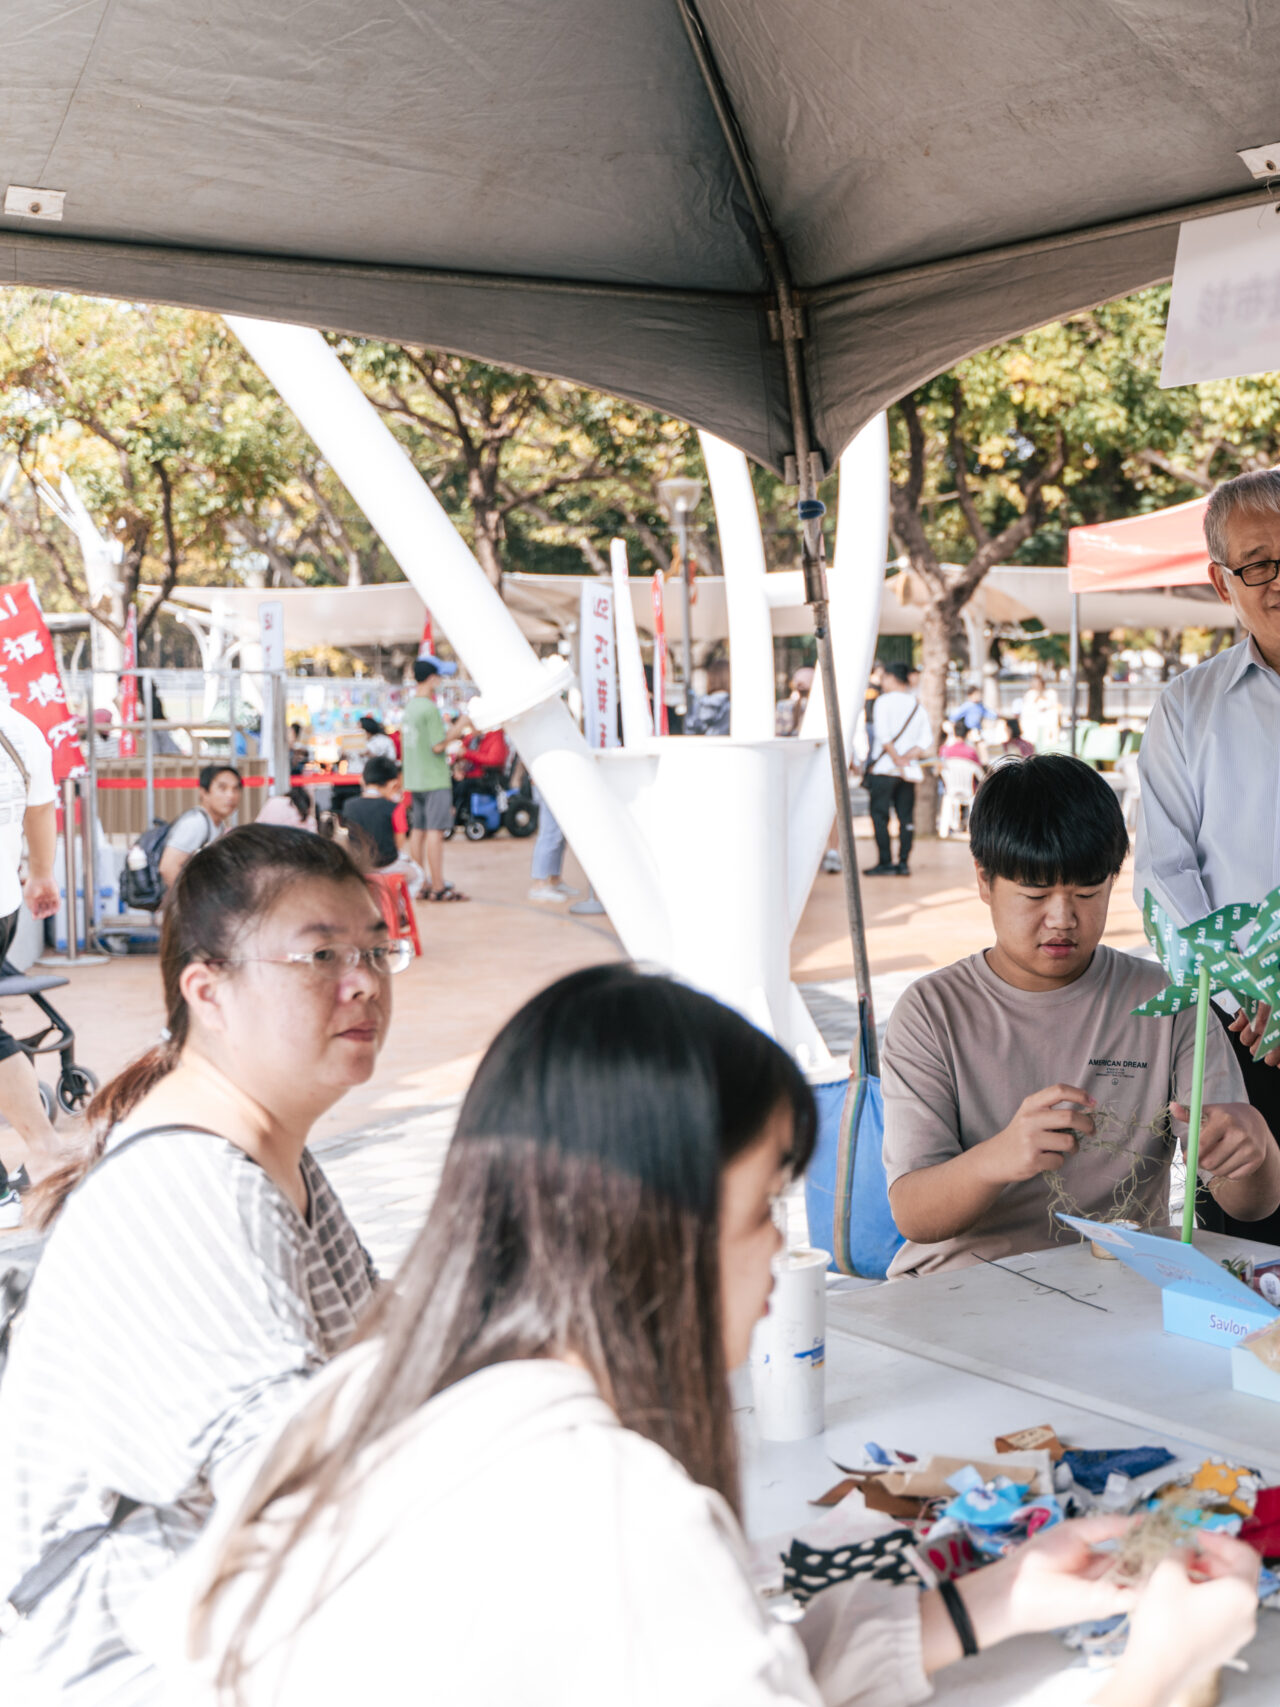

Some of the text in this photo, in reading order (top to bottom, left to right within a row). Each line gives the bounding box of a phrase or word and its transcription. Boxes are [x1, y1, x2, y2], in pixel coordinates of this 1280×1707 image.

[1088, 1058, 1148, 1069] AMERICAN DREAM
[1209, 1314, 1248, 1337] Savlon
